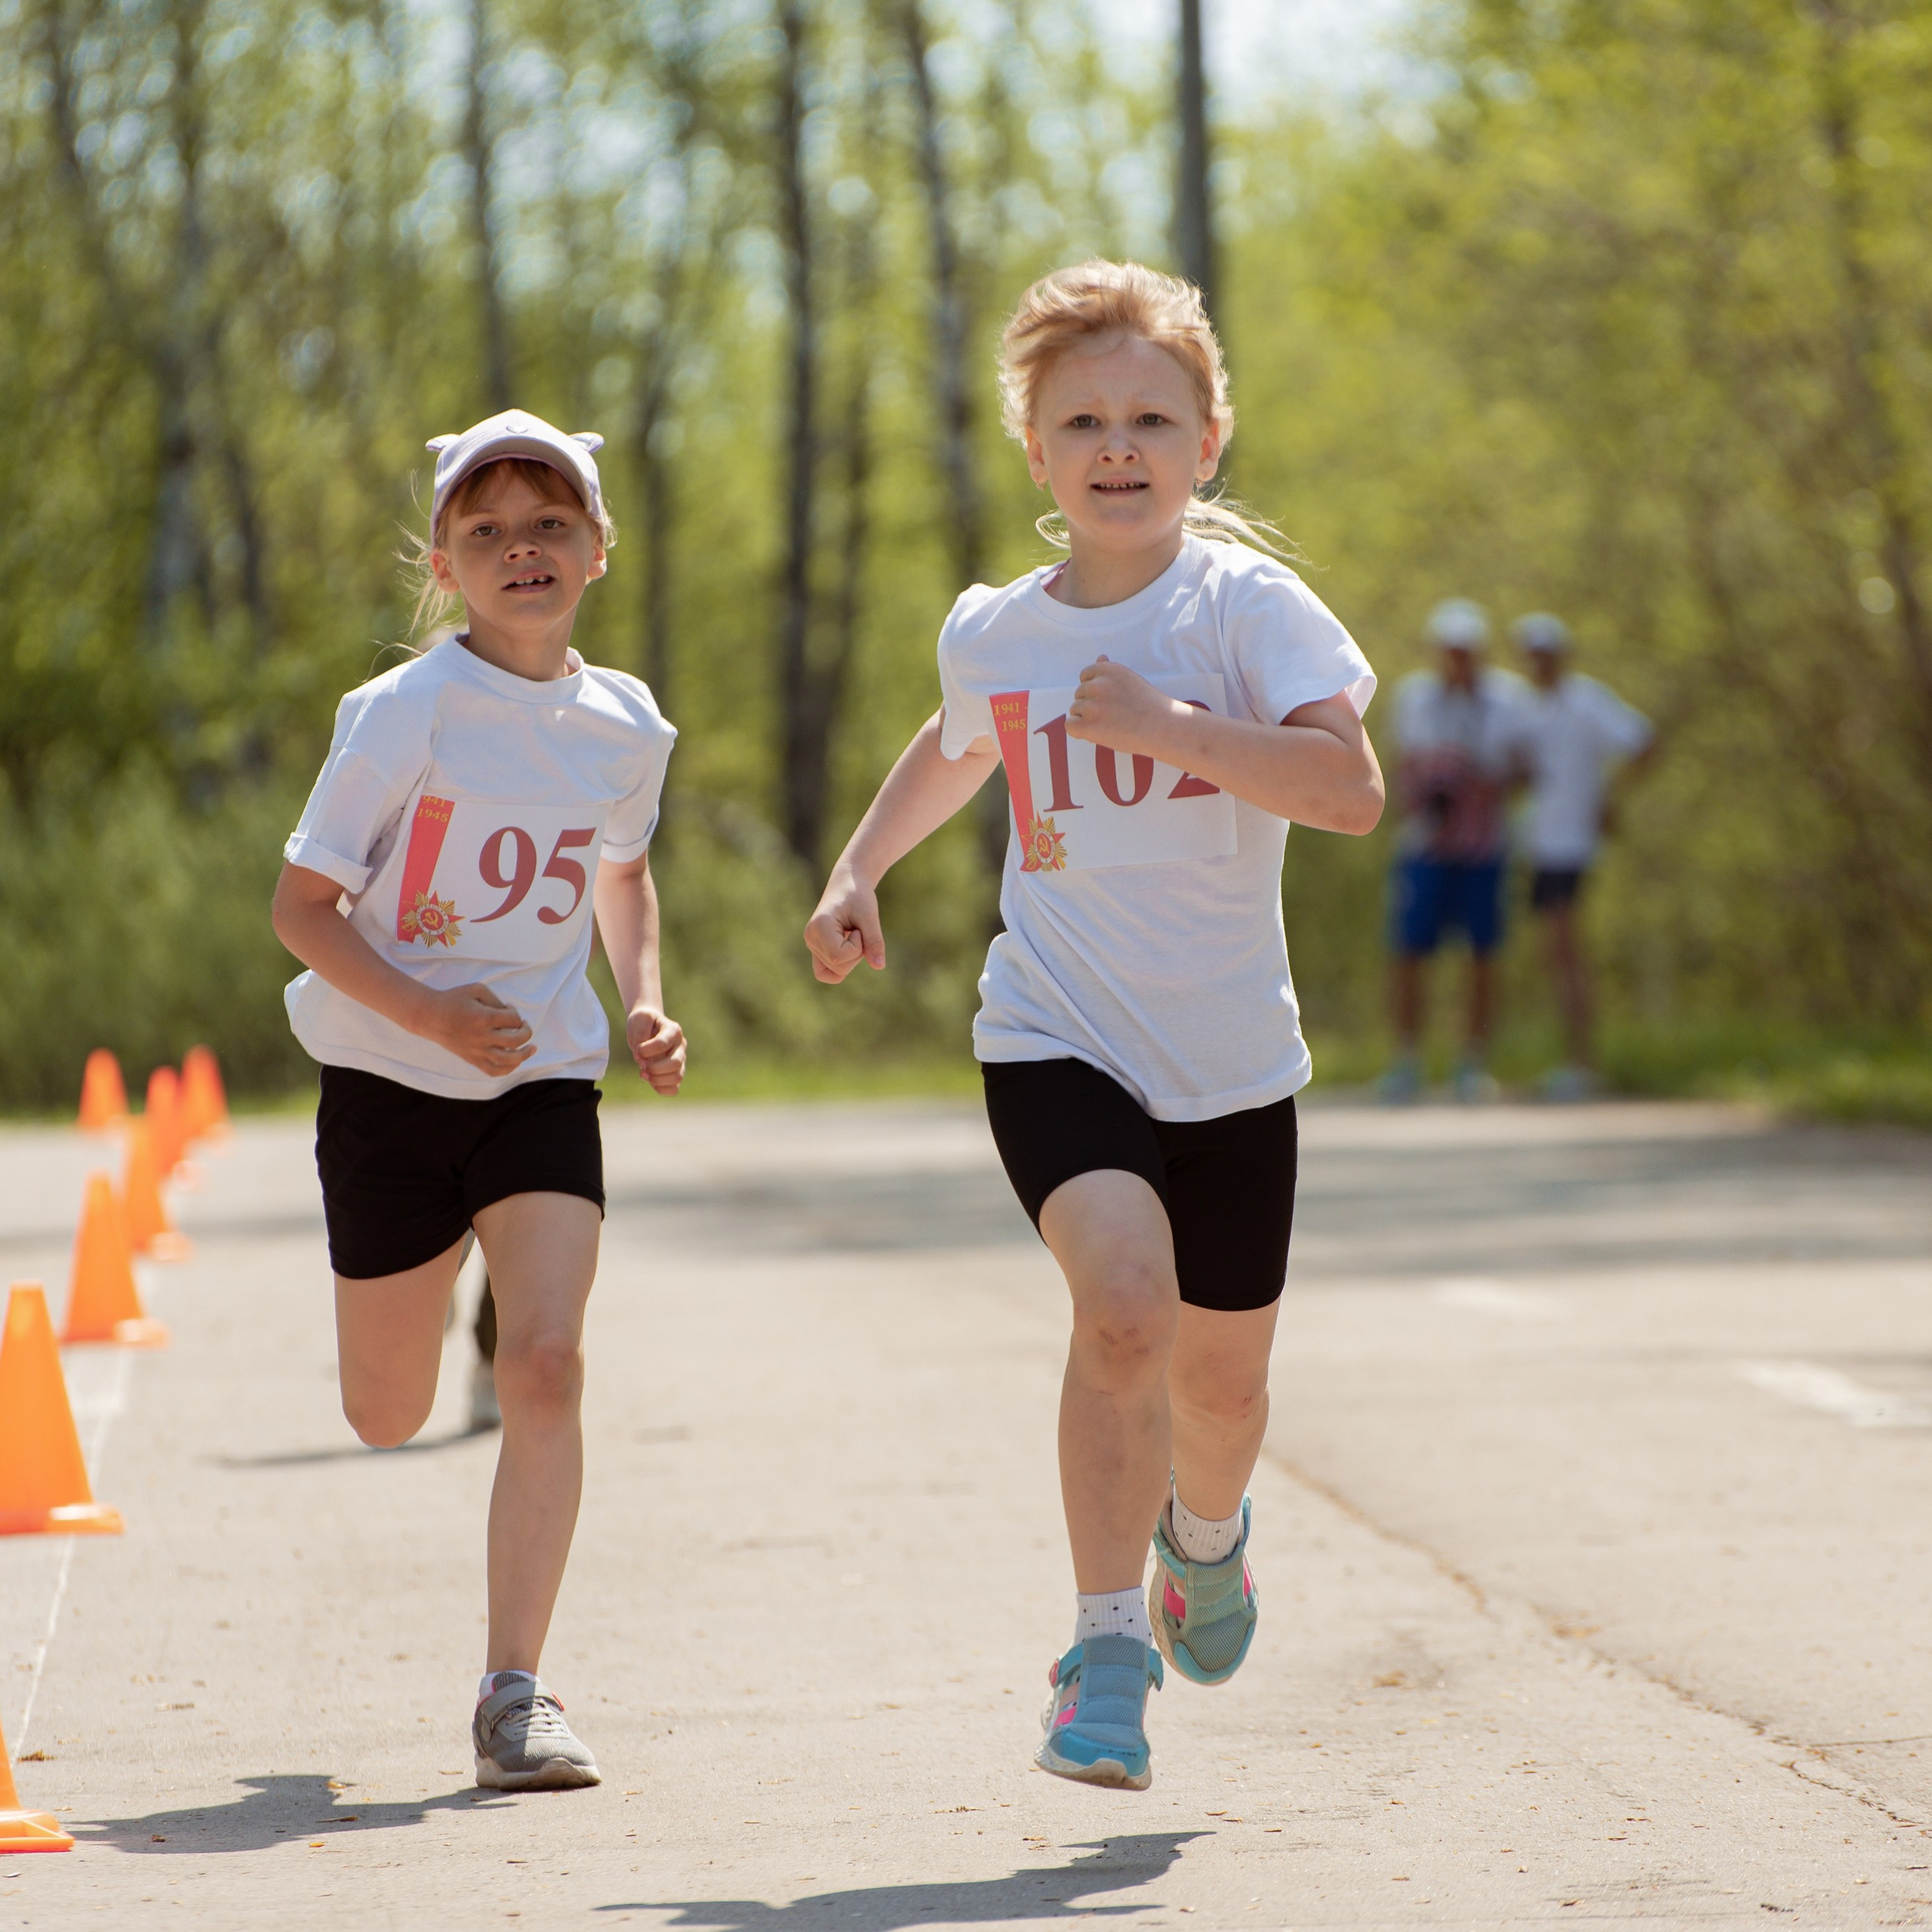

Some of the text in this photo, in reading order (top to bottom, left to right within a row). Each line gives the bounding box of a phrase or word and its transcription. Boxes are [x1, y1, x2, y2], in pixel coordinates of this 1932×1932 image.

[994, 701, 1020, 715] 1941
[1002, 718, 1026, 732] 1945
[417, 808, 448, 823] 1945
[469, 826, 596, 924] 95
